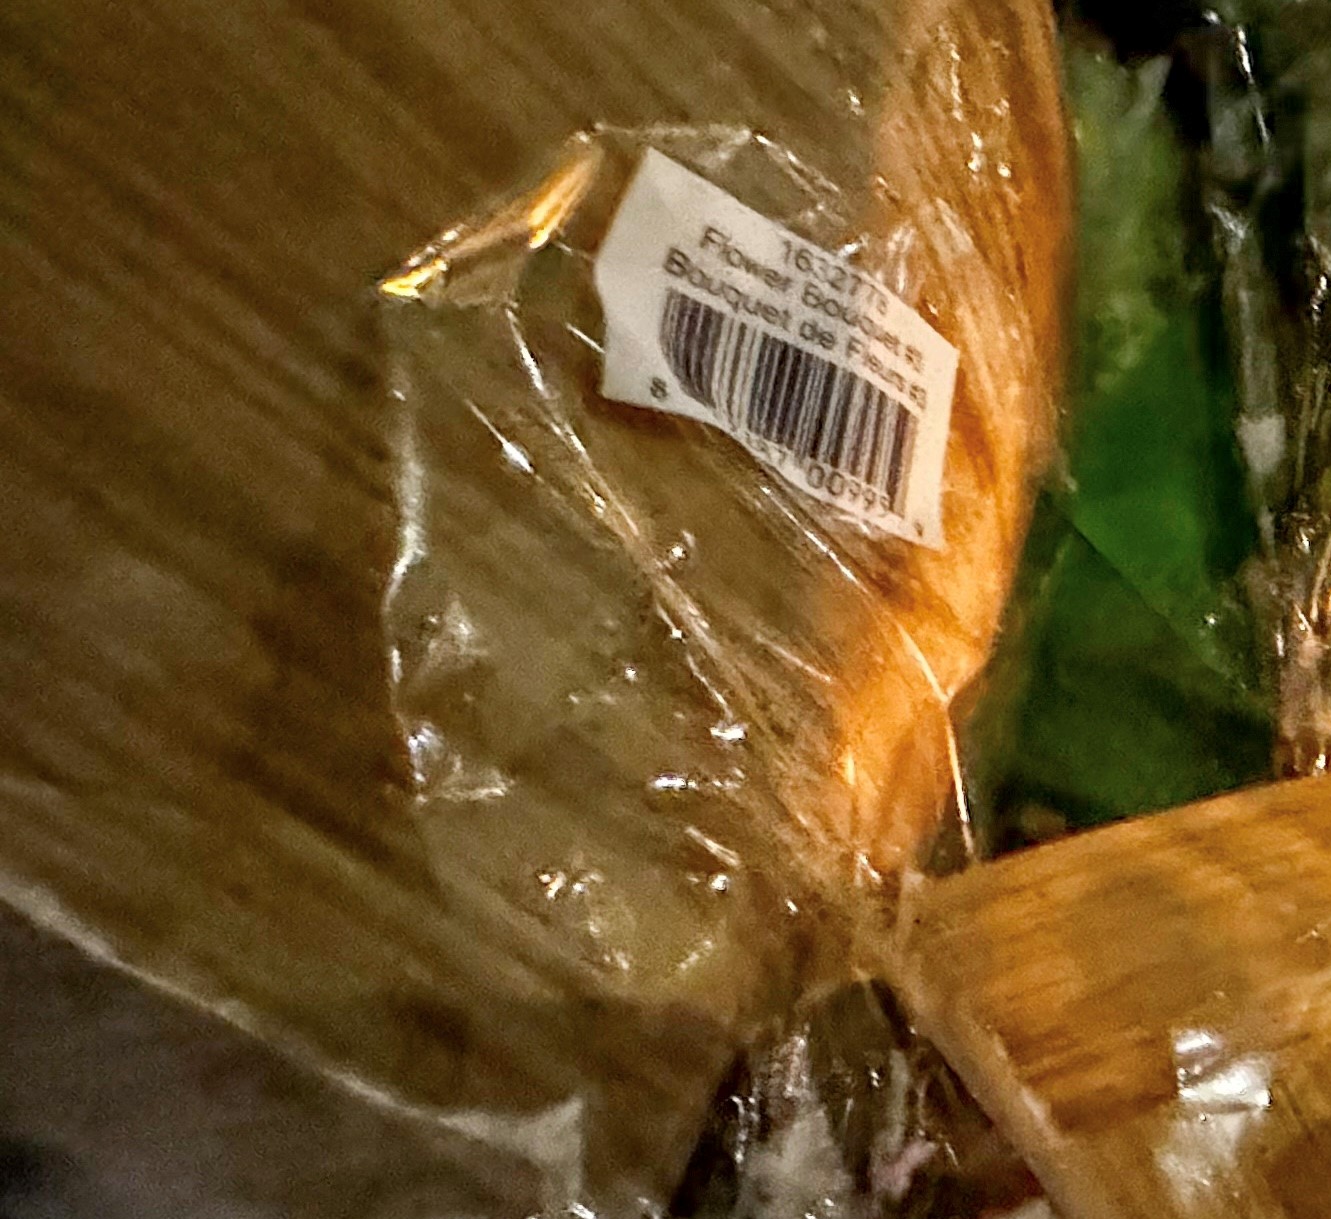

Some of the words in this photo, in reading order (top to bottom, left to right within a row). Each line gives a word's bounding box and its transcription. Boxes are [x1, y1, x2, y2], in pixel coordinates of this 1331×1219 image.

[663, 246, 792, 331] Bouquet
[799, 319, 836, 350] de
[847, 334, 905, 394] Fleurs
[700, 225, 793, 292] Flower
[801, 282, 900, 357] Bouquet
